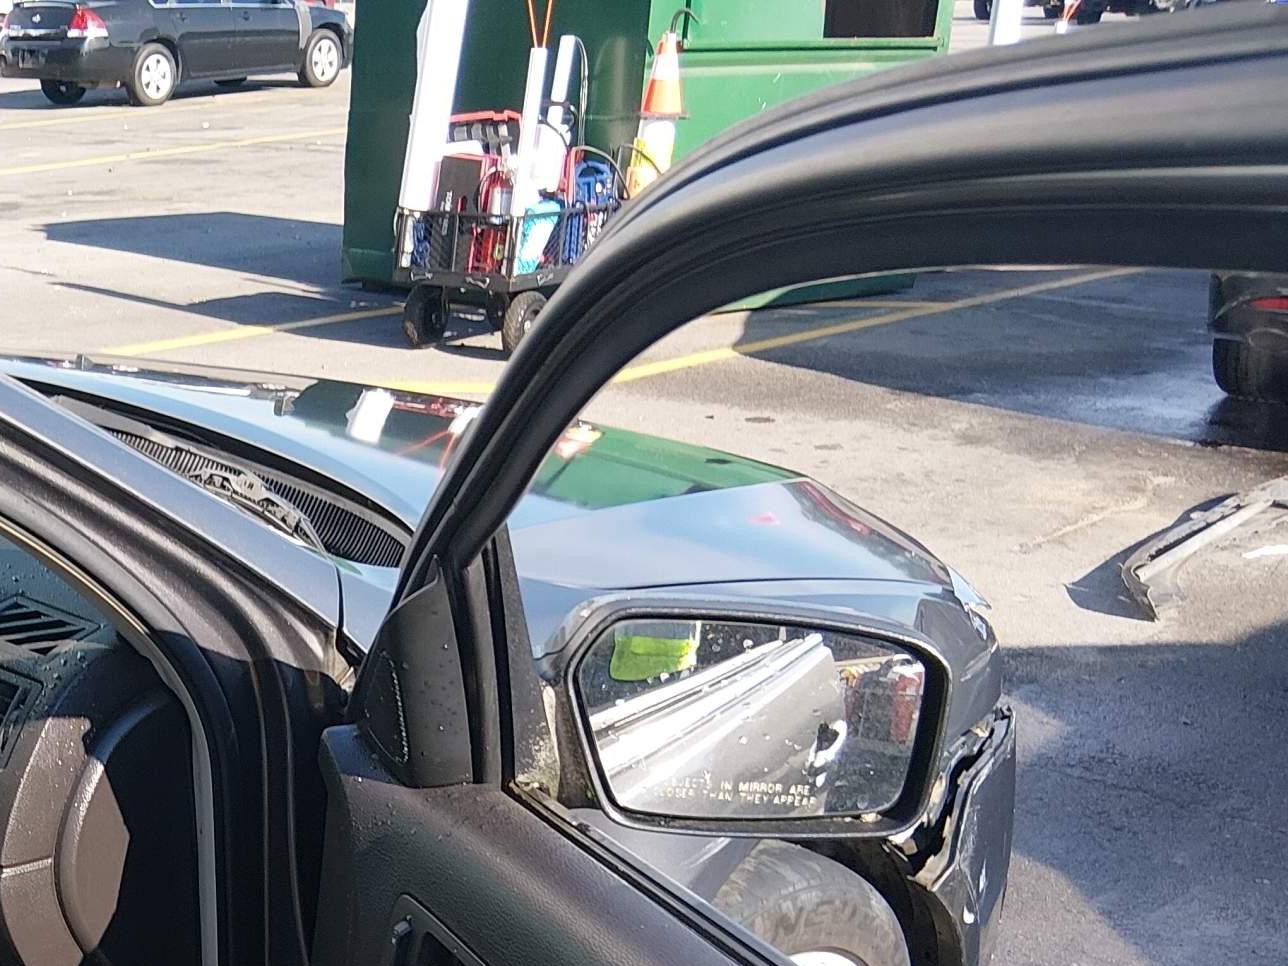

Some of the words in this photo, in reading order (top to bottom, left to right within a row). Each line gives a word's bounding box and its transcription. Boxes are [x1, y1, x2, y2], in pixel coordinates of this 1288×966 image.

[720, 781, 733, 791] IN
[738, 782, 783, 794] MIRROR
[788, 784, 811, 796] ARE
